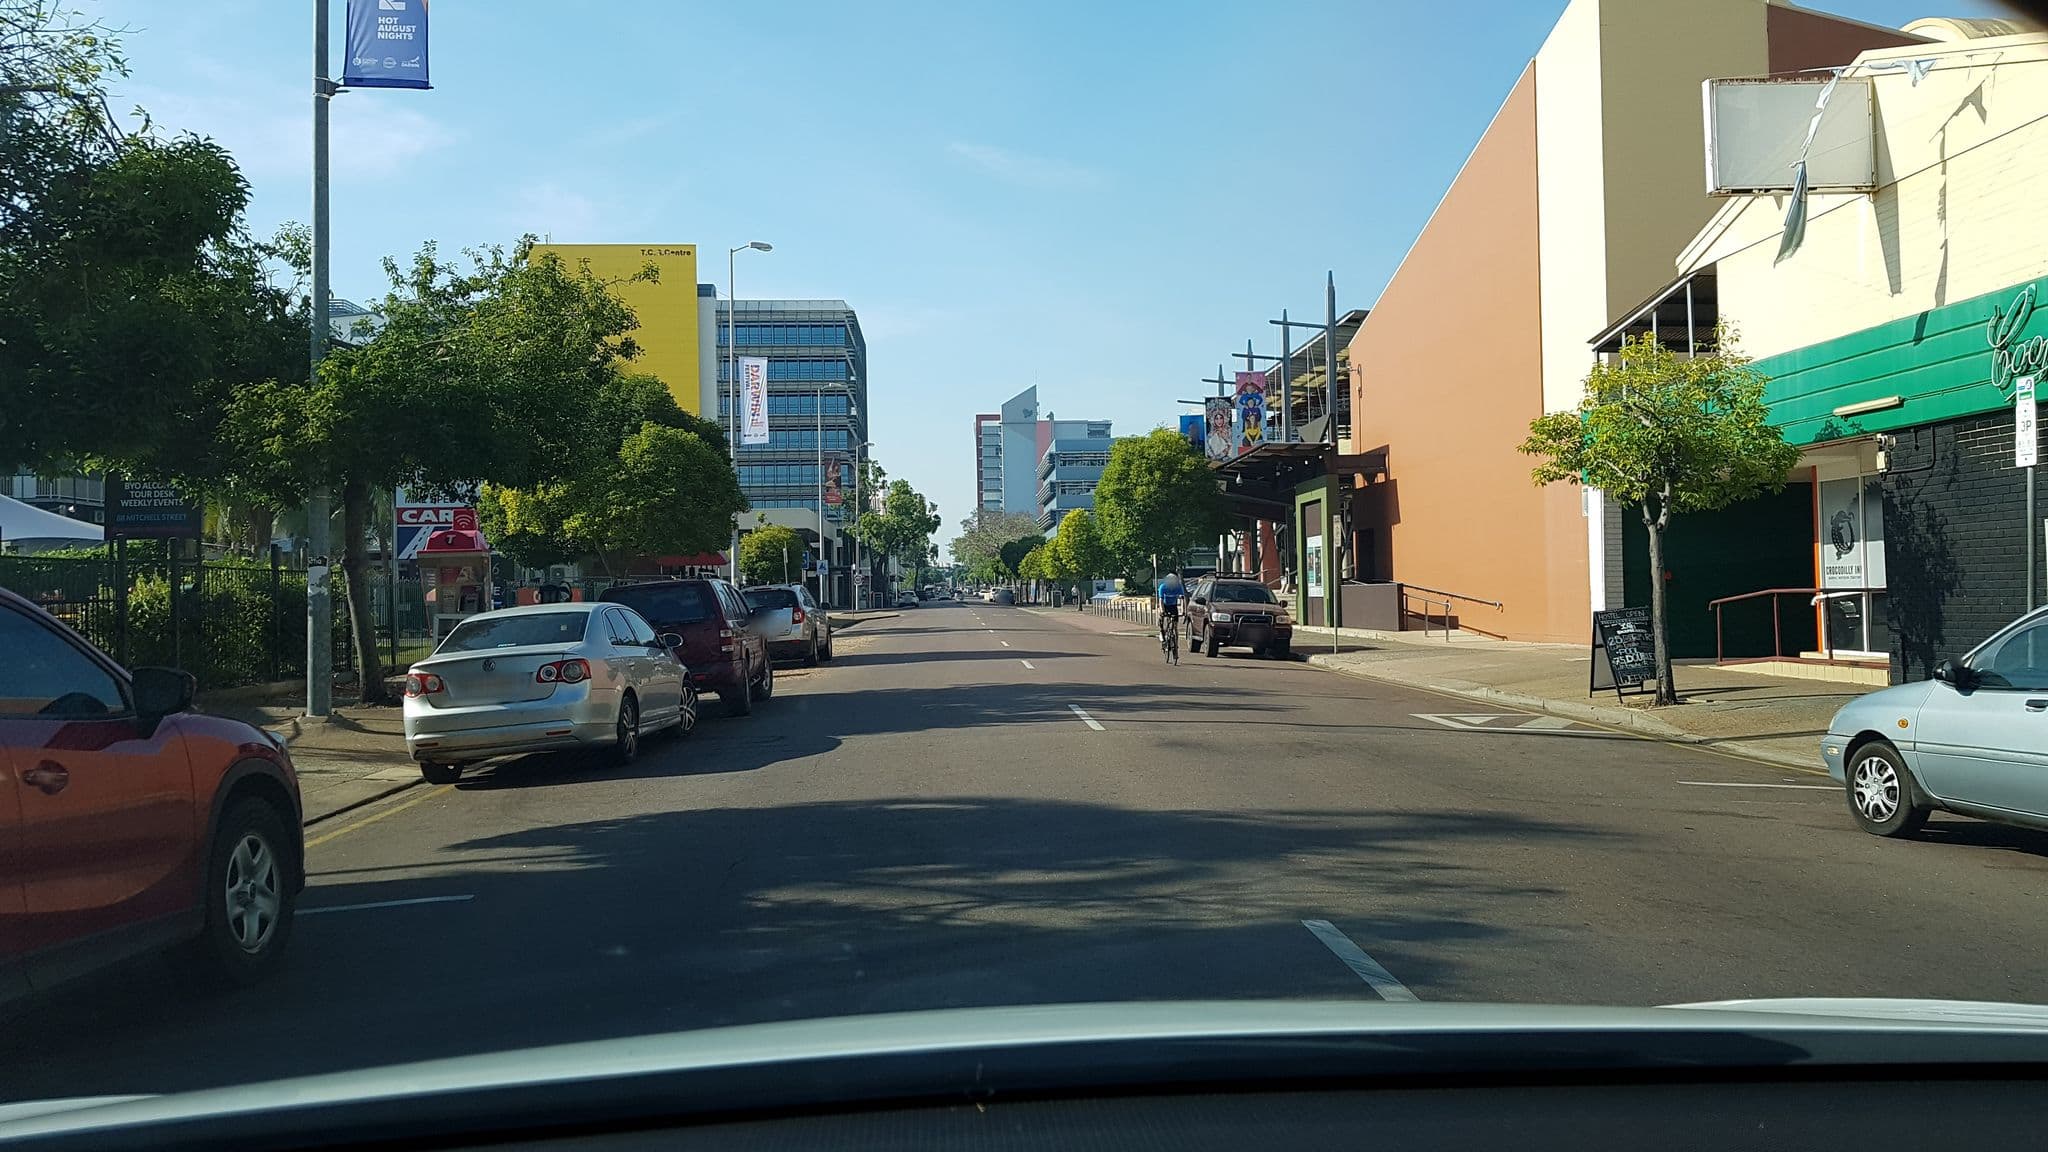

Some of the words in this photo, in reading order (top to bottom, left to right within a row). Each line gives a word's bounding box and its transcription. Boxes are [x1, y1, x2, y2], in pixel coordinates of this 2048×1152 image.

[378, 16, 399, 25] HOT
[377, 24, 417, 33] AUGUST
[377, 31, 414, 40] NIGHTS
[124, 482, 142, 490] BYO
[130, 490, 153, 499] TOUR
[153, 490, 175, 498] DESK
[120, 499, 153, 507] WEEKLY
[153, 499, 184, 507] EVENTS
[161, 513, 187, 521] STREET
